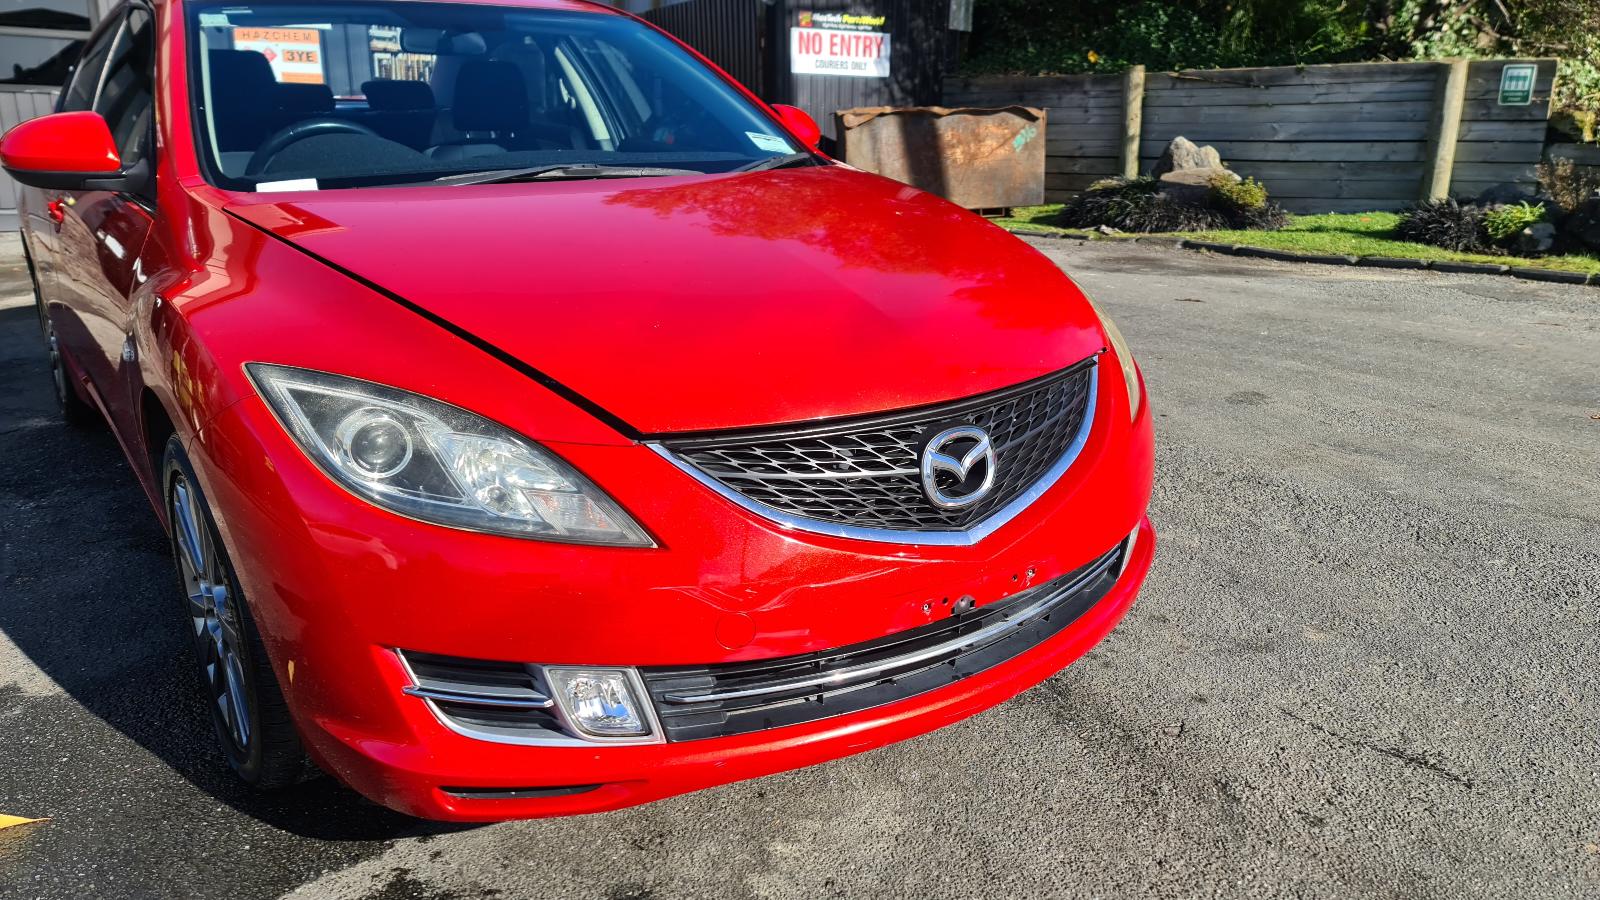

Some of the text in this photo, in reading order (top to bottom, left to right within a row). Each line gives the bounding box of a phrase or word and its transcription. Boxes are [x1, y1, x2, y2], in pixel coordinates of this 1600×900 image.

[242, 31, 312, 41] HAZCHEM
[799, 31, 884, 58] NO ENTRY
[287, 50, 315, 62] 3YE
[815, 59, 868, 71] COURIERS ONLY
